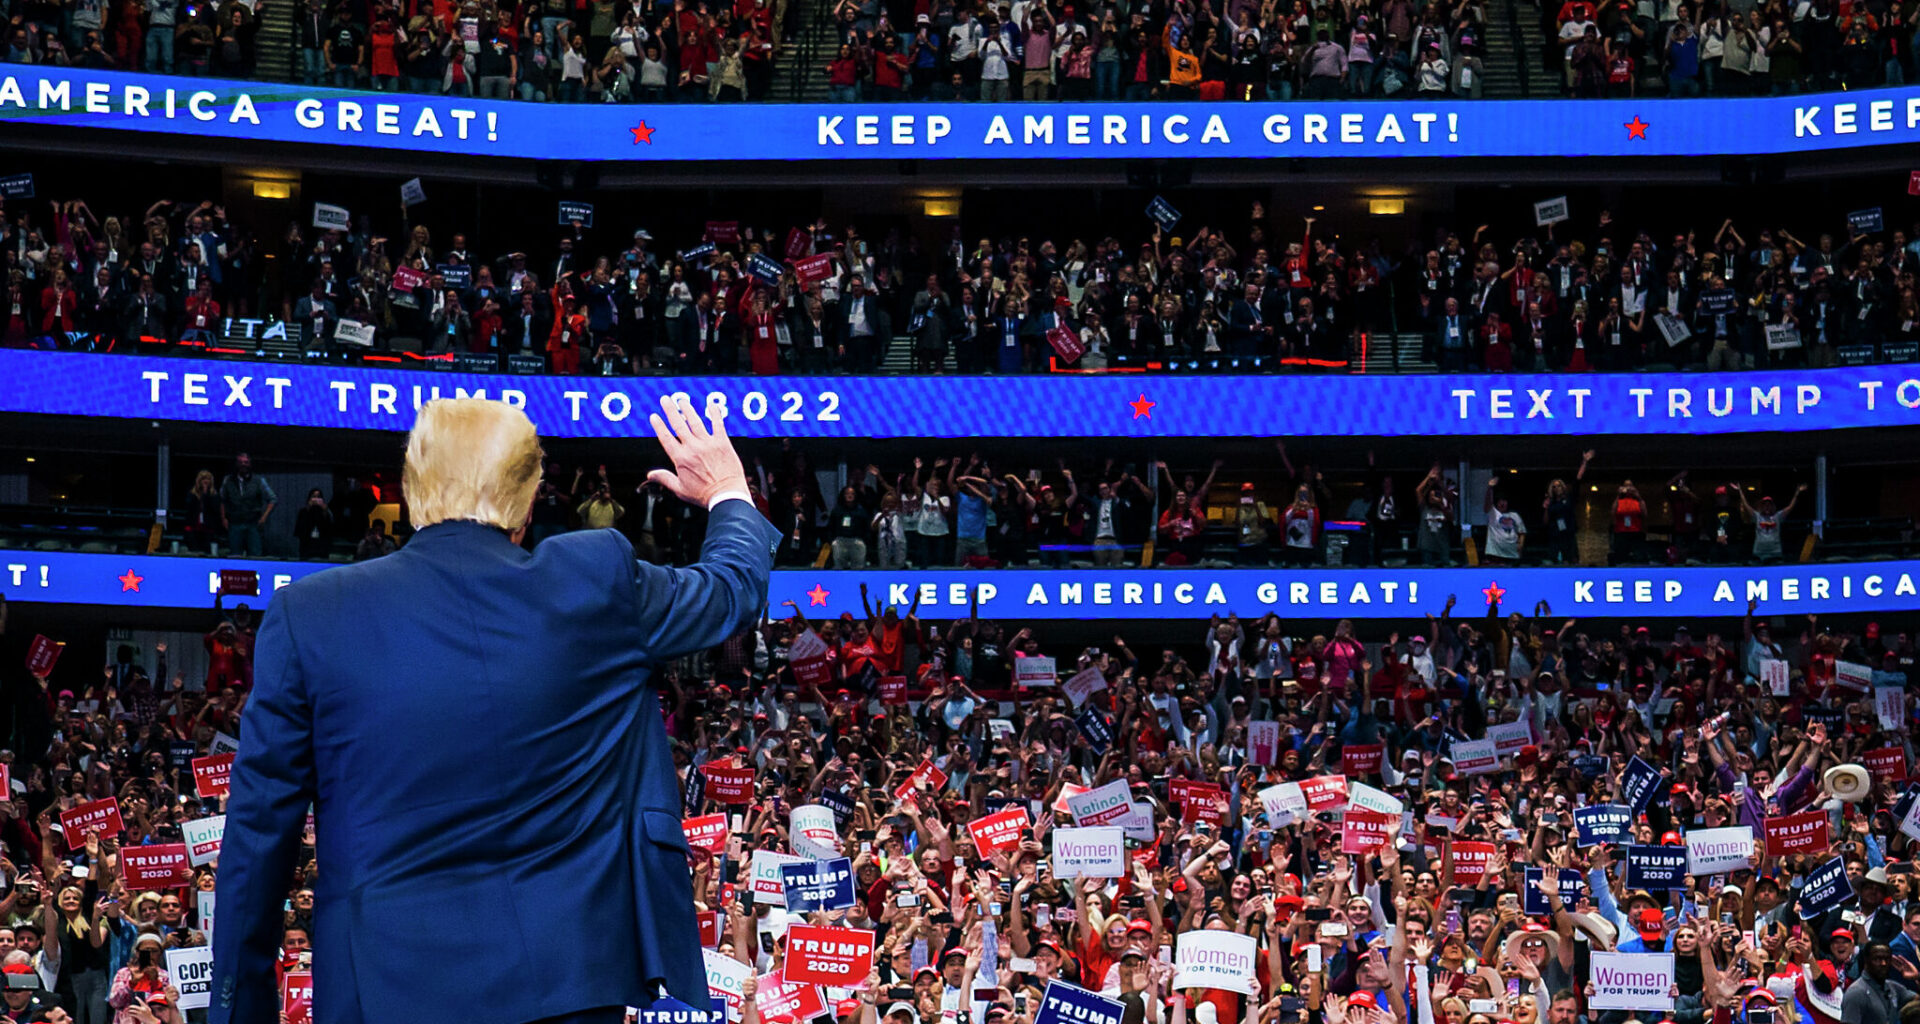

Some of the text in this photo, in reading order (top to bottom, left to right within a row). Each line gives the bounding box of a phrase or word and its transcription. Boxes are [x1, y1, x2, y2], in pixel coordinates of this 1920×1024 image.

[0, 77, 497, 142] AMERICA GREAT!
[818, 113, 1458, 145] KEEP AMERICA GREAT!
[142, 371, 292, 410] TEXT
[563, 391, 632, 422] TO
[1452, 379, 1920, 419] TEXT TRUMP TO
[890, 582, 1418, 605] KEEP AMERICA GREAT!
[1574, 574, 1917, 603] KEEP AMERICA
[1344, 751, 1382, 761] TRUMP
[1454, 748, 1493, 761] Latinos
[706, 774, 752, 785] TRUMP
[716, 787, 742, 796] 2020
[1306, 781, 1345, 794] RUMP
[1073, 793, 1125, 817] Latinos
[1100, 804, 1128, 820] TRUMP
[65, 807, 117, 829] TRUMP
[1577, 814, 1629, 826] TRUMP
[80, 822, 108, 837] 220
[683, 822, 725, 838] RUMP
[974, 816, 1027, 839] TRUMP
[1591, 826, 1620, 836] 2020
[1768, 820, 1825, 838] TRUMP
[991, 832, 1020, 846] 2020
[1358, 836, 1385, 846] 2020
[1783, 835, 1813, 849] 2020
[1058, 841, 1118, 858] Women
[1691, 839, 1748, 857] Women
[125, 855, 186, 867] TRUMP
[1064, 857, 1113, 866] FOR TRUMP
[1631, 855, 1685, 866] TRUMP
[1699, 854, 1744, 864] FOR TRUMP
[140, 870, 174, 879] 2020
[1455, 865, 1484, 874] 2020
[1642, 871, 1673, 880] 2020
[785, 870, 849, 887] TRUMP
[1528, 879, 1585, 890] TMP
[757, 882, 777, 891] FOR
[802, 889, 836, 902] 2020
[1810, 886, 1836, 905] 2020
[791, 938, 870, 957] TRUMP
[1181, 946, 1249, 970] Women
[807, 960, 851, 974] 2020
[1209, 966, 1242, 977] TRUMP
[1595, 967, 1667, 987] Women
[183, 983, 208, 993] FOR
[1603, 987, 1661, 996] FOR TRUMP
[763, 998, 801, 1020] 2020
[1047, 996, 1118, 1024] TRUMP
[643, 1010, 723, 1024] TRUMP
